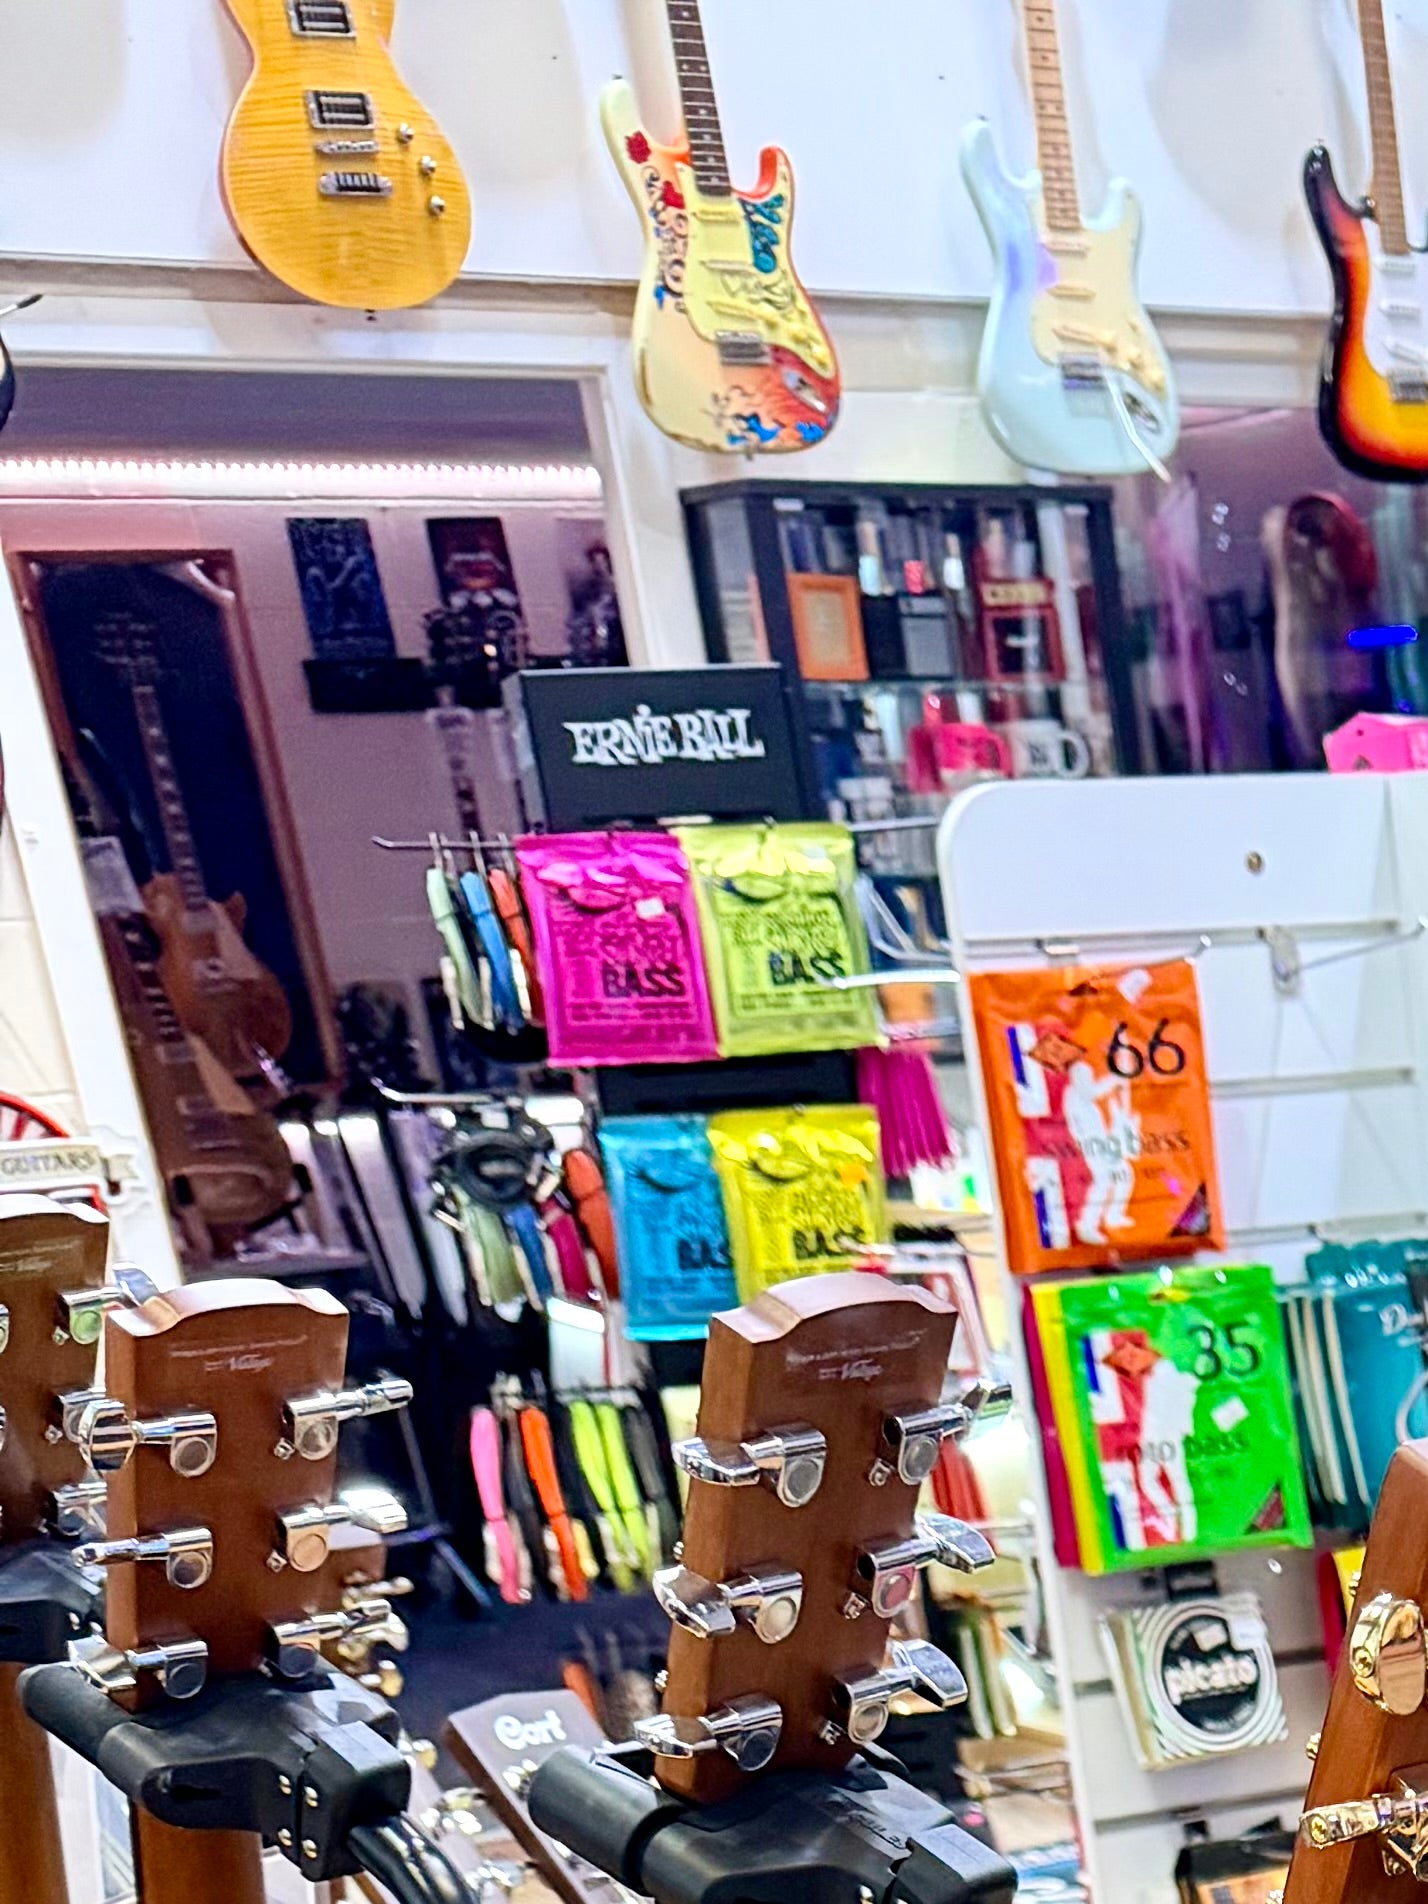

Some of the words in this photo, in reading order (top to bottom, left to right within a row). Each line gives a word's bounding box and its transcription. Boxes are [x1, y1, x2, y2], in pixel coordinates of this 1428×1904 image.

[562, 703, 678, 765] ERNIE
[672, 708, 766, 760] BALL
[601, 962, 686, 998] BASS
[768, 949, 848, 988] BASS
[1106, 1017, 1187, 1079] 66
[1187, 1322, 1260, 1382] 35
[494, 1707, 567, 1751] Cort
